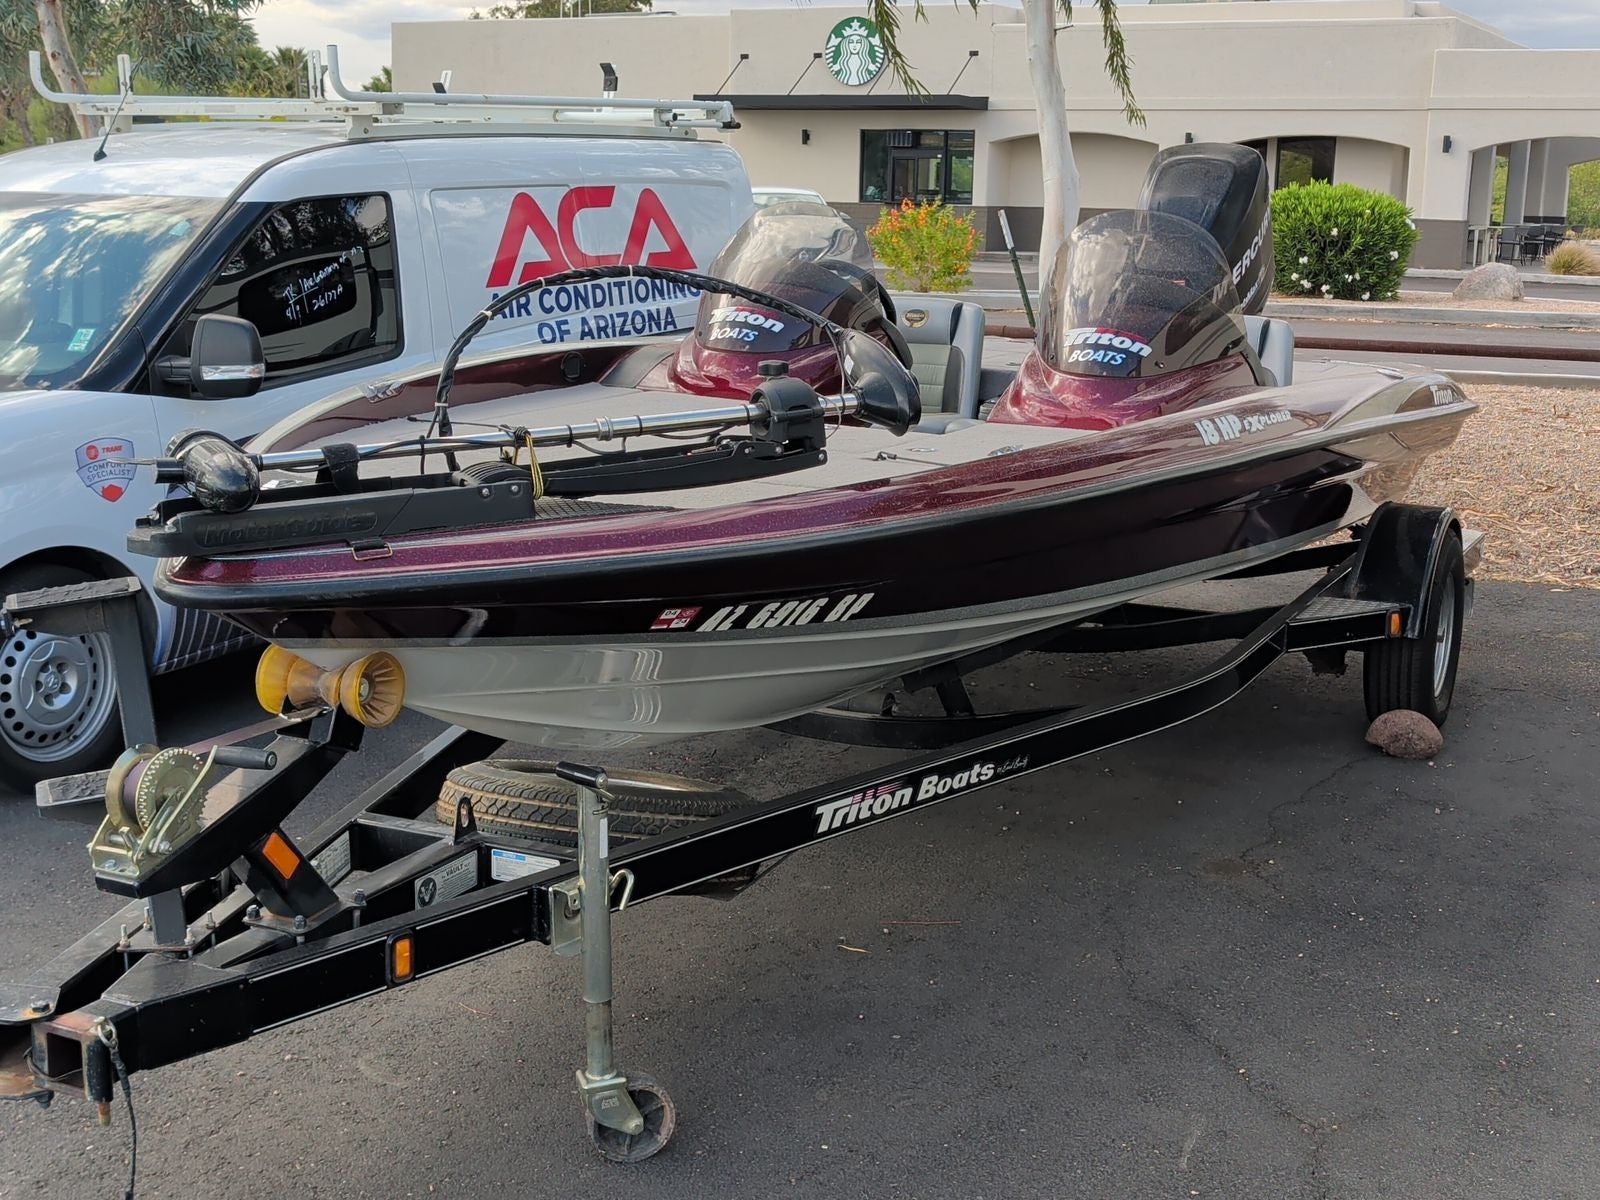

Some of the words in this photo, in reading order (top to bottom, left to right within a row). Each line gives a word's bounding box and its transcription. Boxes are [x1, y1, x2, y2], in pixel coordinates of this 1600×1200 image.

[486, 186, 697, 288] ACA
[1211, 207, 1270, 304] MERCUR
[537, 319, 571, 345] OF
[579, 306, 678, 341] ARIZONA
[709, 306, 785, 333] Triton
[709, 327, 759, 342] BOATS
[1063, 328, 1153, 358] Triton
[1068, 349, 1126, 365] BOATS
[1194, 419, 1220, 446] 18
[1214, 414, 1242, 441] HP
[86, 469, 132, 482] SPECIALIST
[87, 462, 127, 474] COMFORT
[695, 604, 749, 632] AZ
[745, 598, 830, 630] 6916
[815, 786, 914, 834] Triton
[916, 763, 995, 802] Boats
